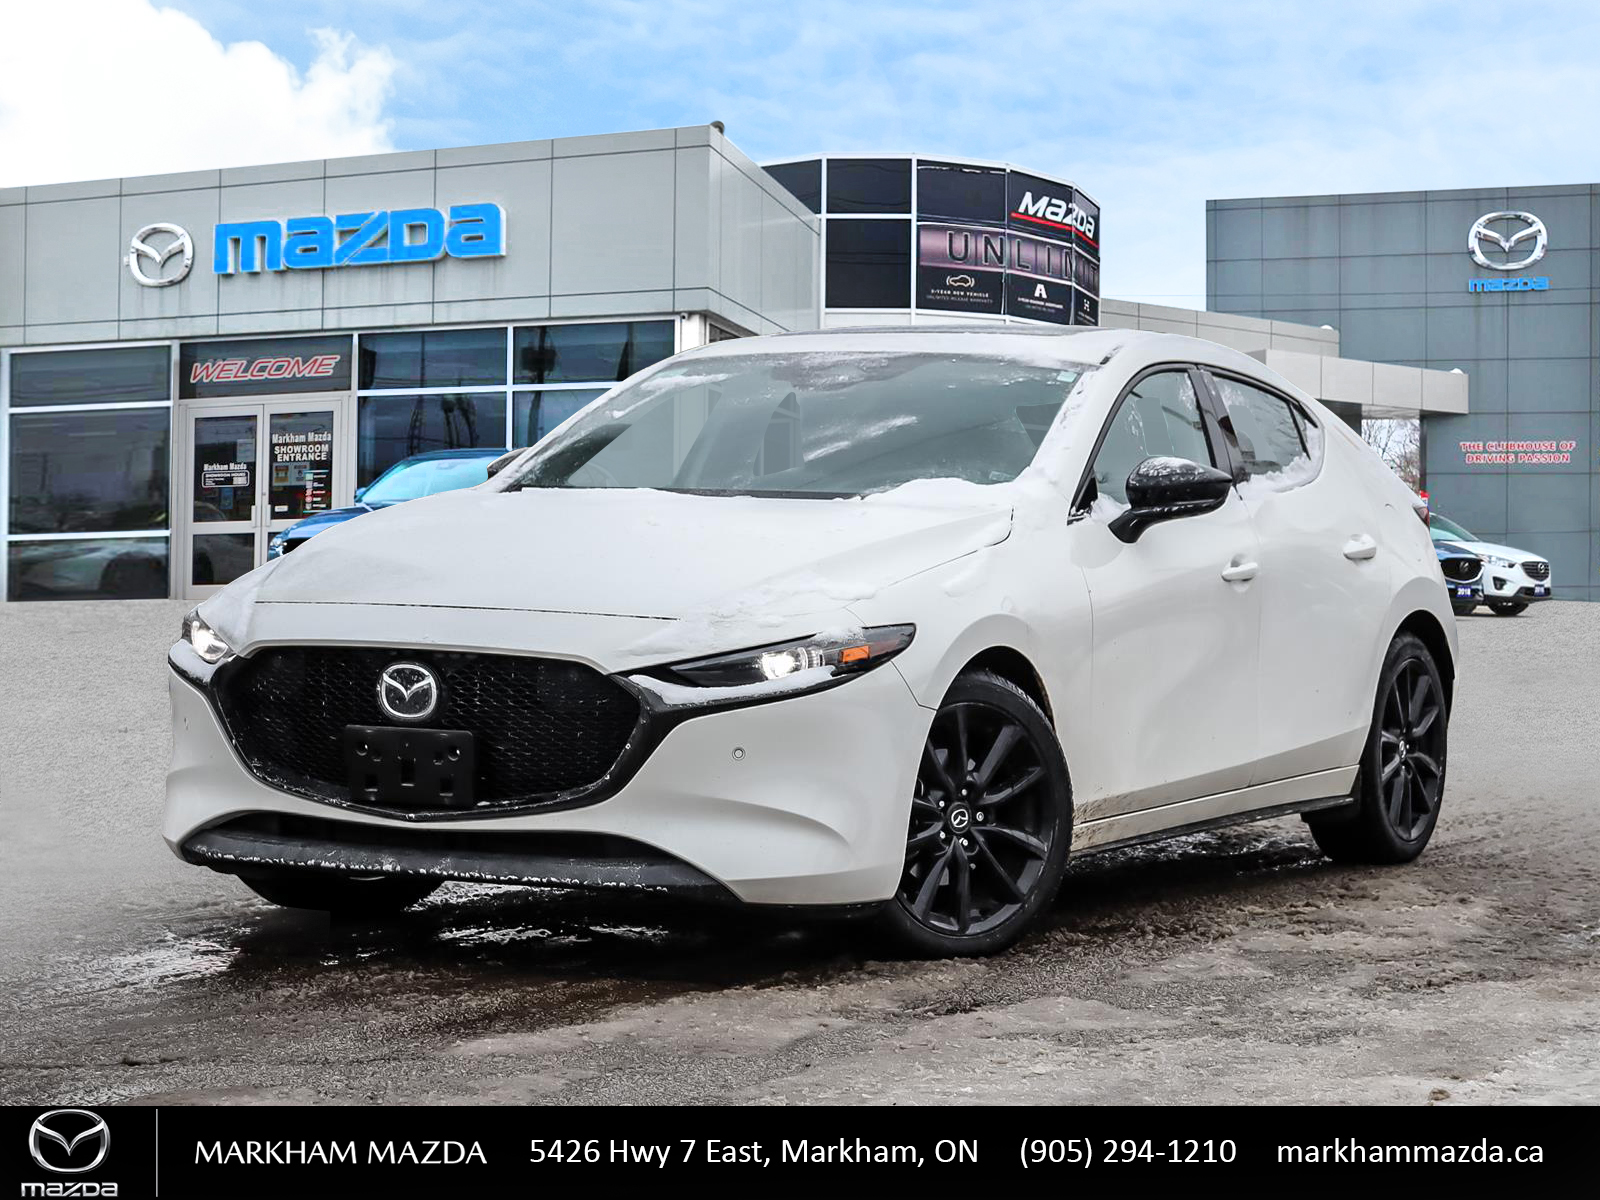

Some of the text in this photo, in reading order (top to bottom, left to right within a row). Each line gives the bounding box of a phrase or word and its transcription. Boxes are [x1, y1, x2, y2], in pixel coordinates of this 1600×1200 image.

[1018, 191, 1095, 239] Mazda
[213, 203, 506, 275] mazda
[1468, 276, 1549, 292] mazda
[190, 355, 340, 383] WELCOME
[272, 431, 332, 444] Markham Mazda
[274, 444, 329, 454] SHOWROOM
[1460, 441, 1576, 452] THE CLUBHOUSE OF
[277, 452, 327, 462] ENTRANCE
[1466, 453, 1571, 464] DRIVING PASSION
[203, 462, 247, 471] Markham Mazda
